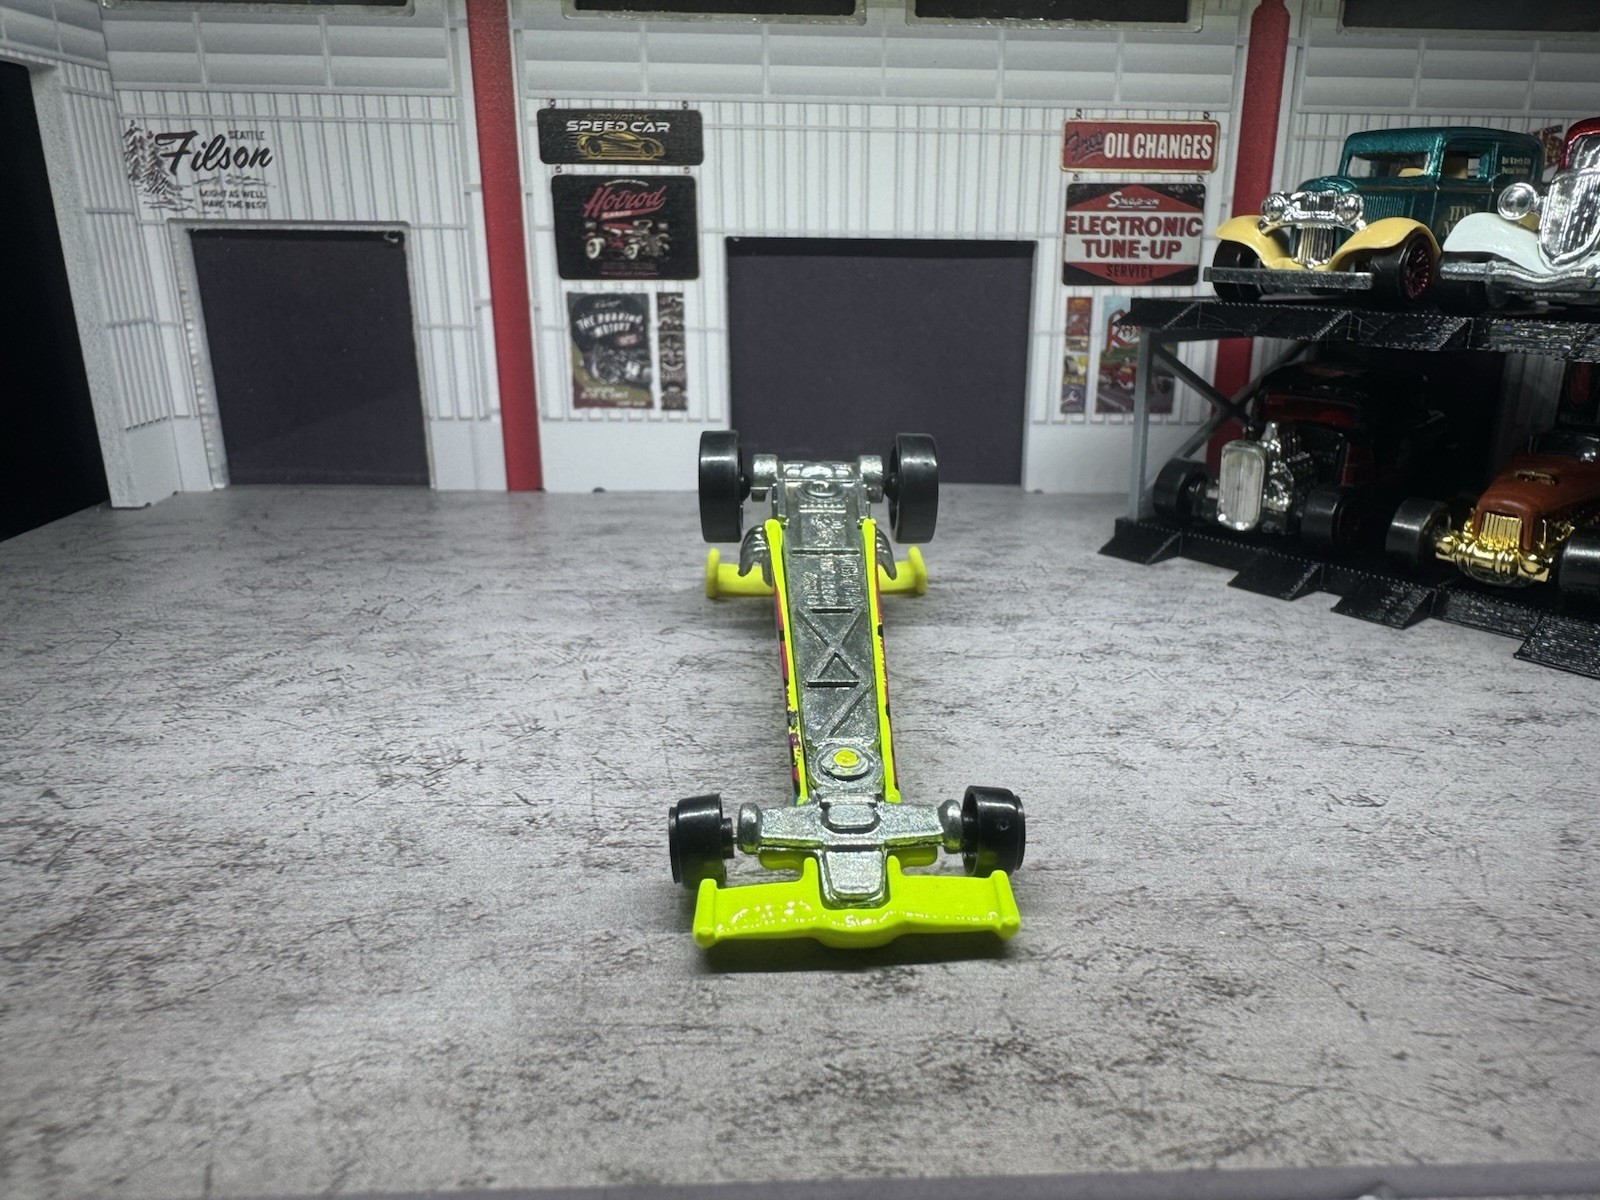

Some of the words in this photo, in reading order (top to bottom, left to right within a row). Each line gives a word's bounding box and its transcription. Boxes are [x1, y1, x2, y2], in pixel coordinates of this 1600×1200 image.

[228, 130, 266, 141] SEATTLE
[566, 120, 628, 132] SPEED
[630, 121, 671, 133] CAR
[154, 130, 274, 176] Filson
[1104, 132, 1131, 159] OIL
[1133, 132, 1213, 160] CHANGES
[241, 189, 267, 199] WELL
[583, 185, 667, 218] Hotrod
[227, 200, 243, 209] THE
[245, 201, 267, 209] BEST
[1064, 215, 1203, 237] ELECTRONIC
[1081, 238, 1183, 259] TUNE-UP
[1105, 264, 1154, 279] SERVICE
